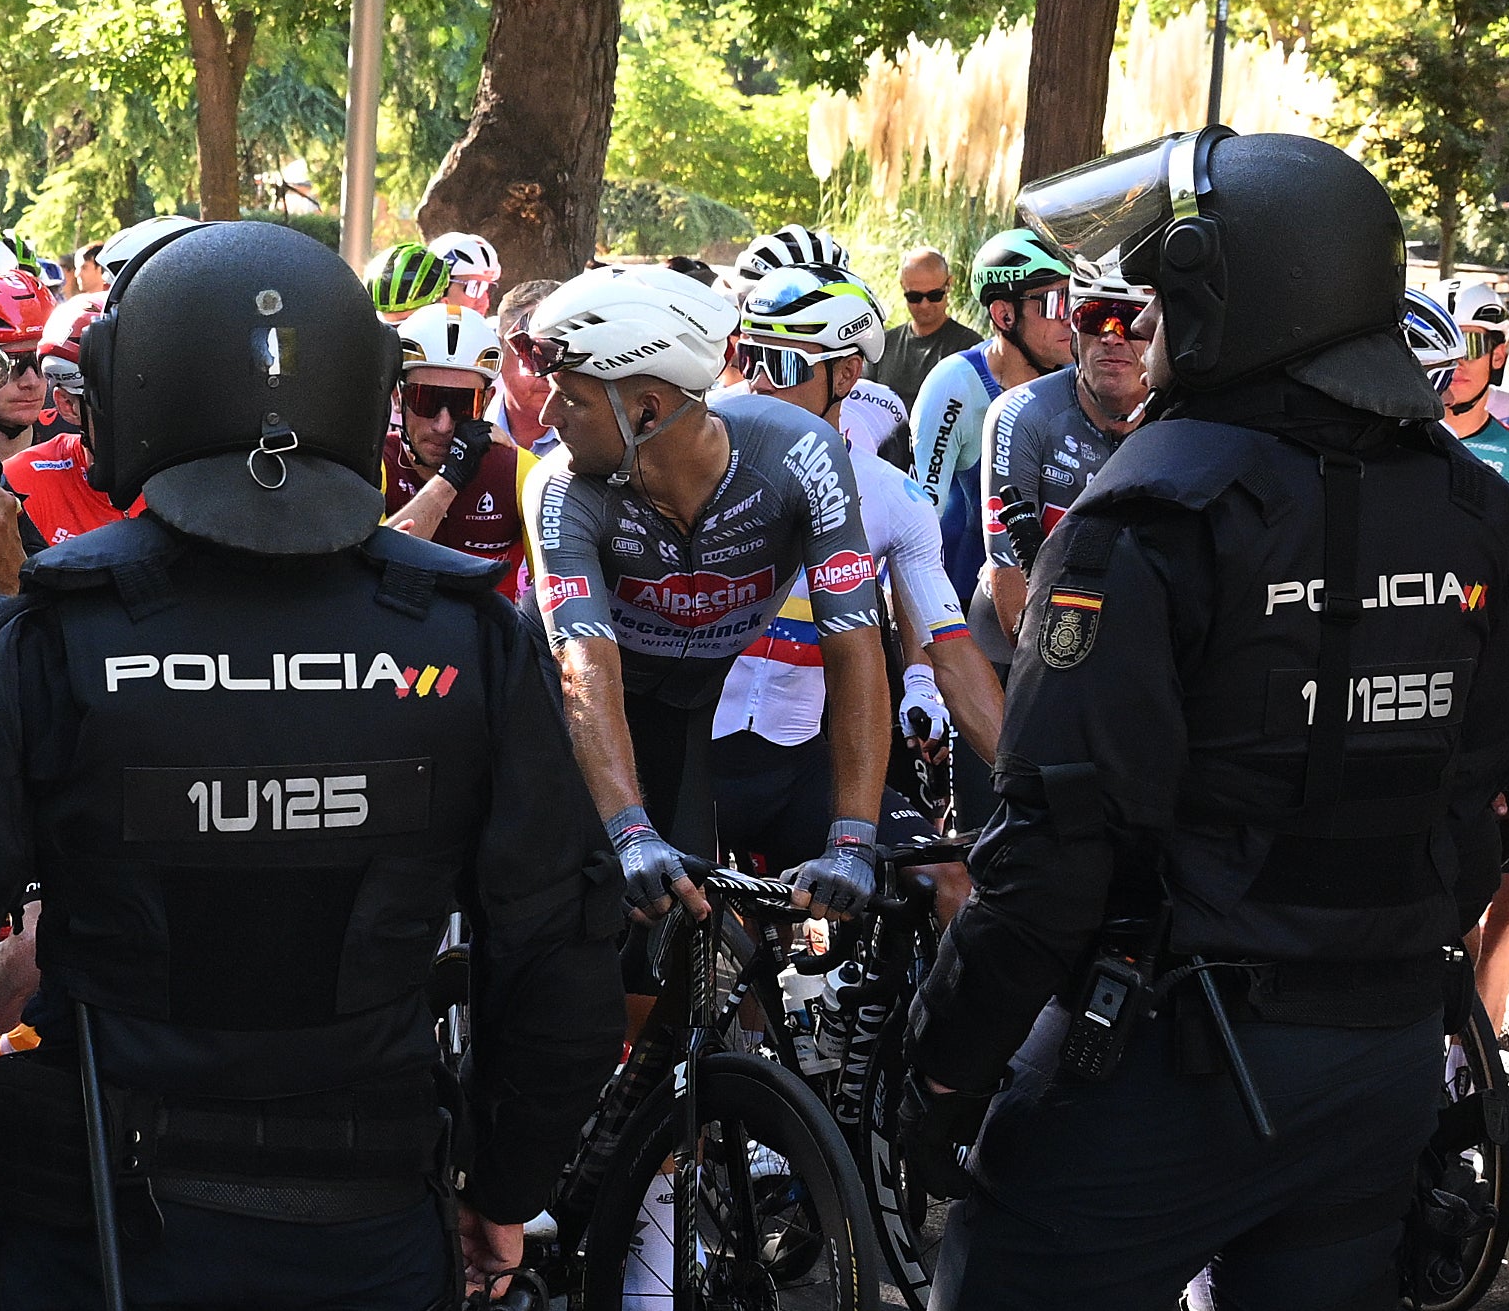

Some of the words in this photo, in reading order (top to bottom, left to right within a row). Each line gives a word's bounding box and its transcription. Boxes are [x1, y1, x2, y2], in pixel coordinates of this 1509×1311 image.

[843, 317, 871, 338] ABUS
[592, 338, 673, 373] CANYON
[860, 392, 904, 423] Analog
[930, 398, 963, 485] DECATHLON
[991, 386, 1037, 477] deceuninck
[787, 430, 852, 533] Alpecin
[1044, 468, 1071, 484] ABUS
[722, 488, 764, 521] ZWIFT
[782, 455, 809, 484] HAIR
[802, 478, 824, 537] BOOSTER
[615, 539, 641, 553] ABUS
[812, 556, 871, 585] Alpecin
[633, 582, 758, 615] Alpecin
[609, 606, 765, 639] deceuninck
[641, 638, 723, 650] WINDOWS
[105, 651, 411, 693] POLICIA
[1301, 671, 1454, 726] 11256
[187, 774, 369, 832] 1U125
